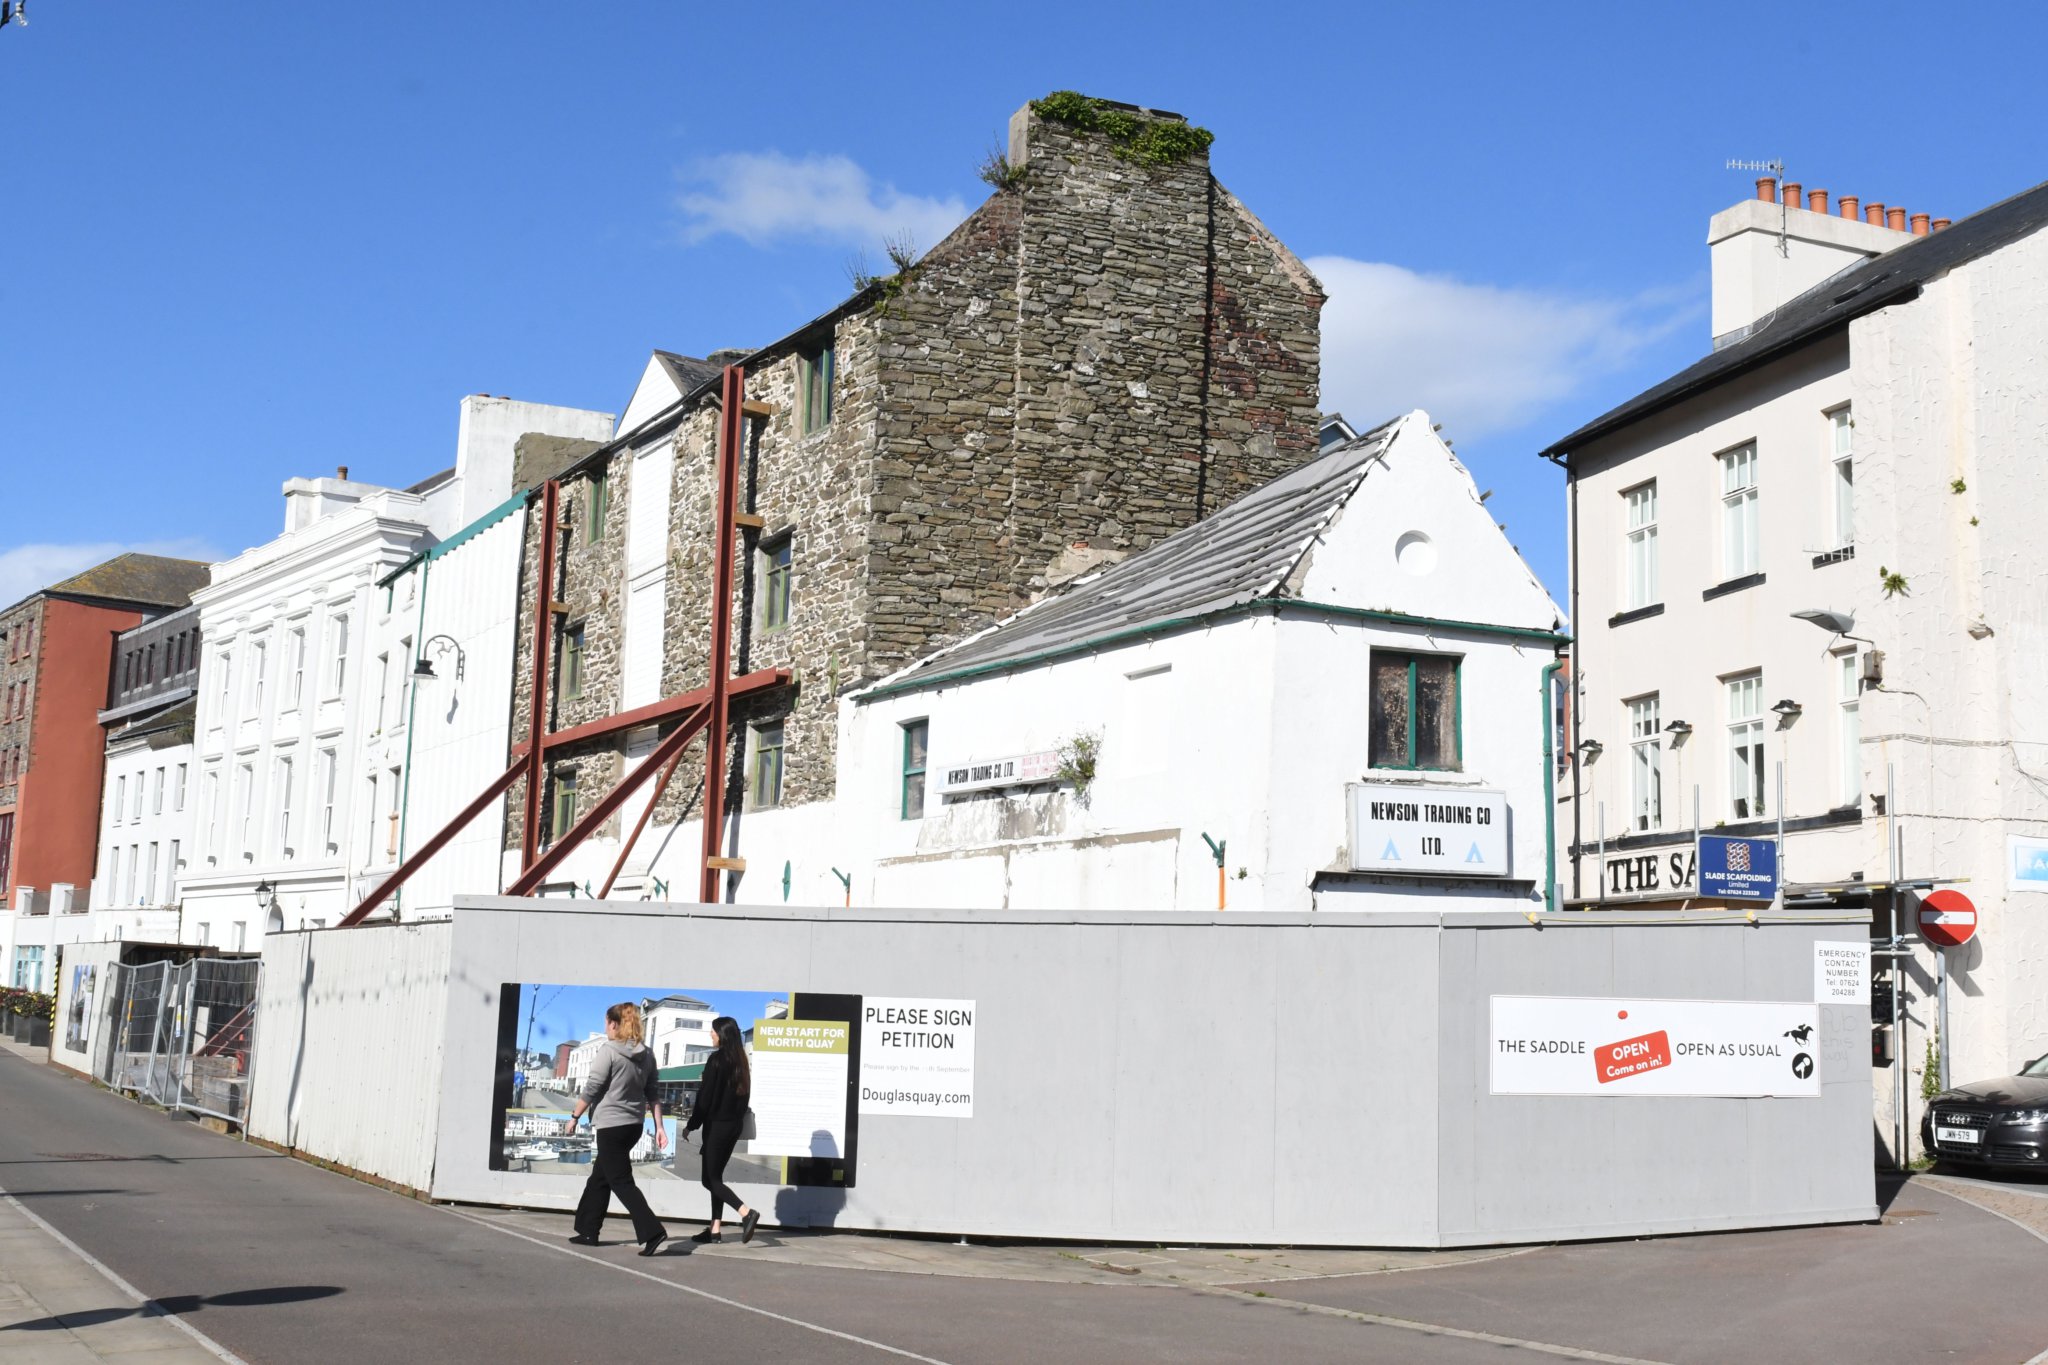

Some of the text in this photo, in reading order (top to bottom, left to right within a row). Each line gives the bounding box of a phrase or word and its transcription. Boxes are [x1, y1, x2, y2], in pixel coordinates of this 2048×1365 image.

[948, 766, 968, 785] NEWSON
[971, 764, 992, 782] TRADING
[994, 763, 1002, 779] CO.
[1004, 761, 1014, 777] LTD.
[1371, 801, 1491, 825] NEWSON TRADING CO
[1422, 837, 1445, 856] LTD.
[1607, 855, 1660, 893] THE
[1705, 871, 1772, 883] SLADE SCAFFOLDING
[1728, 881, 1750, 889] Limited
[1819, 949, 1866, 958] EMERGENCY
[866, 1007, 972, 1026] PLEASE SIGN
[760, 1026, 845, 1038] NEW START FOR
[881, 1031, 954, 1049] PETITION
[767, 1037, 835, 1049] NORTH QUAY
[1499, 1039, 1586, 1055] THE SADDLE
[1612, 1040, 1650, 1061] OPEN
[1676, 1043, 1781, 1058] OPEN AS USUAL
[863, 1063, 884, 1071] Please
[1606, 1054, 1663, 1078] Come on in!
[862, 1088, 971, 1106] Douglasquay.com
